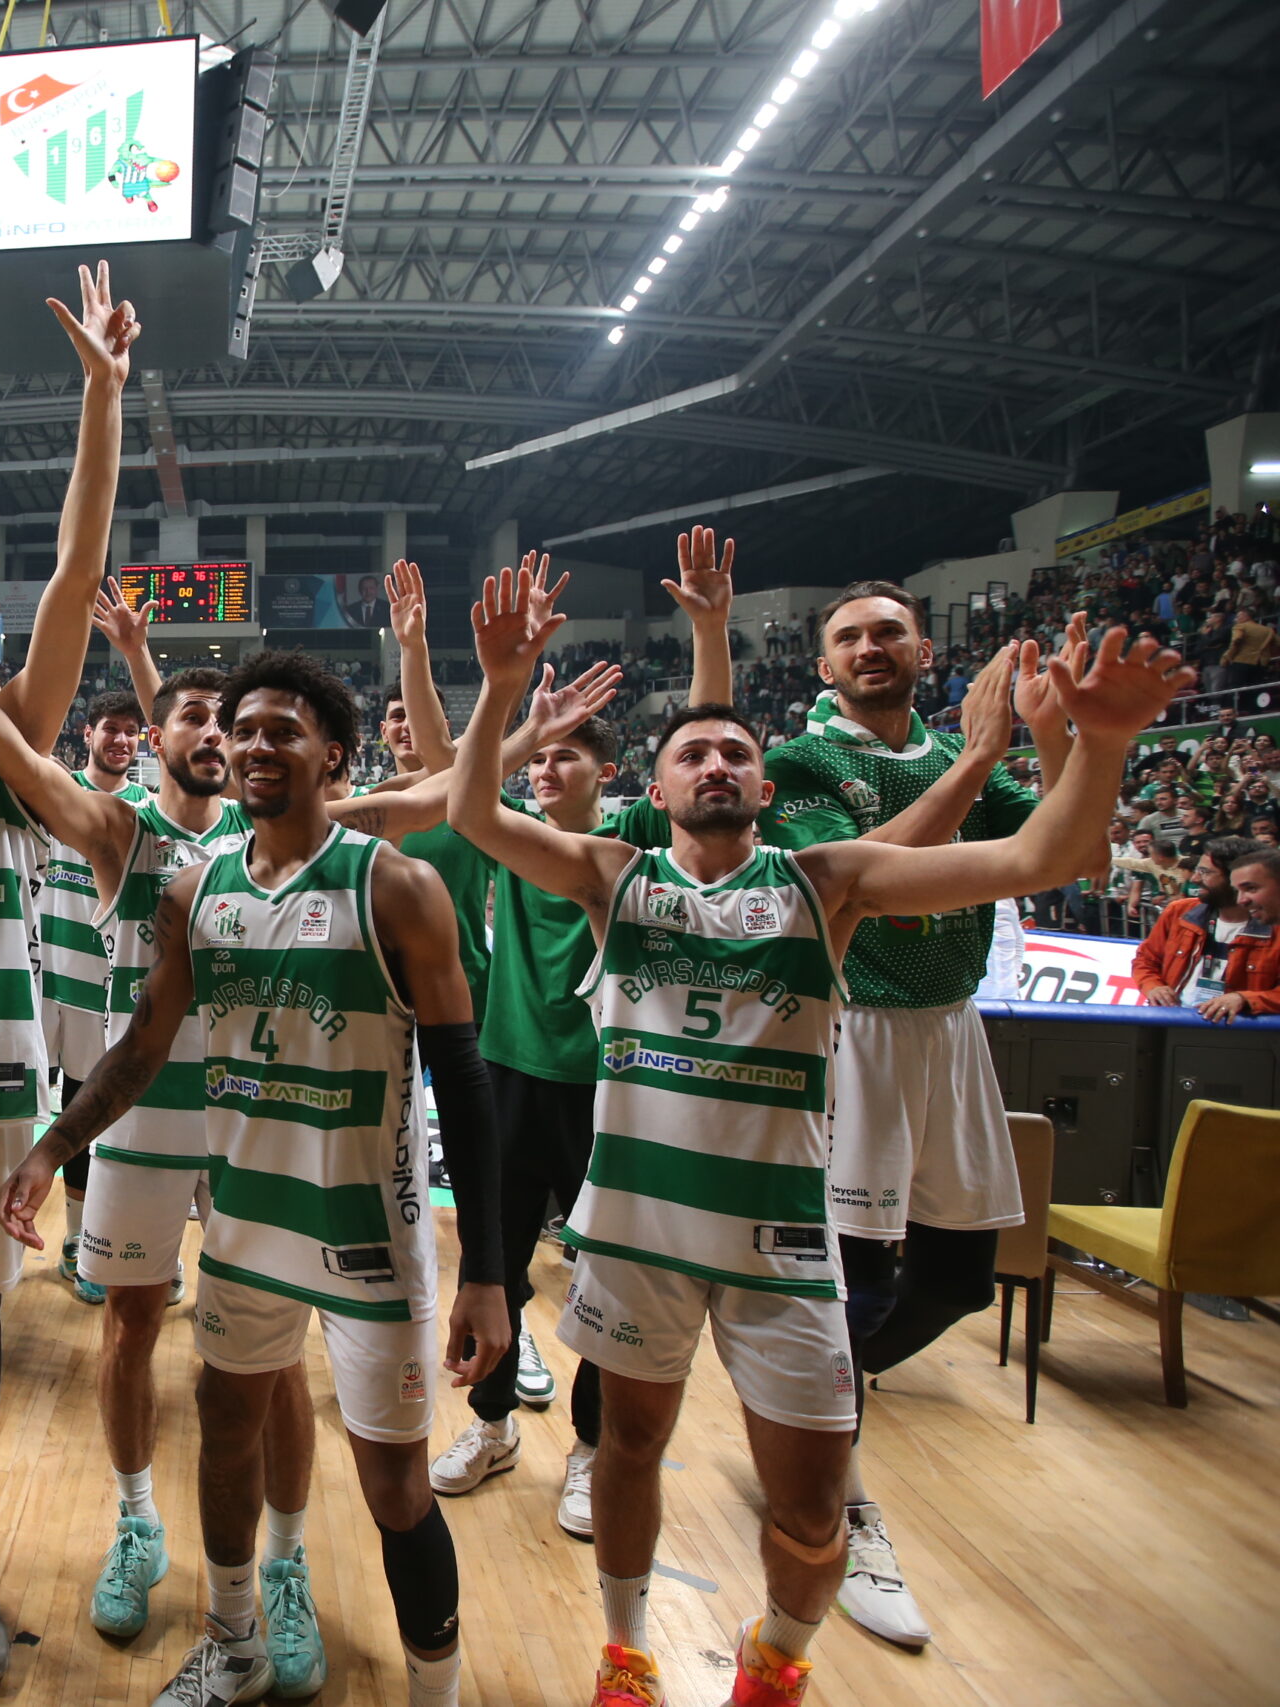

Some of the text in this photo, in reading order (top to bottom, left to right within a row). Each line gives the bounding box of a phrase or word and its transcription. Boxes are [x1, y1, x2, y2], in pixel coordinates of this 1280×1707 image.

[171, 571, 186, 582] 82
[193, 571, 206, 581] 76
[641, 939, 673, 952] upon
[211, 962, 236, 976] upon
[618, 957, 802, 1023] BURSASPOR
[681, 989, 723, 1040] 5
[250, 1011, 280, 1062] 4
[878, 1198, 900, 1210] upon
[119, 1250, 146, 1262] upon
[201, 1318, 226, 1337] upon
[610, 1328, 644, 1348] upon
